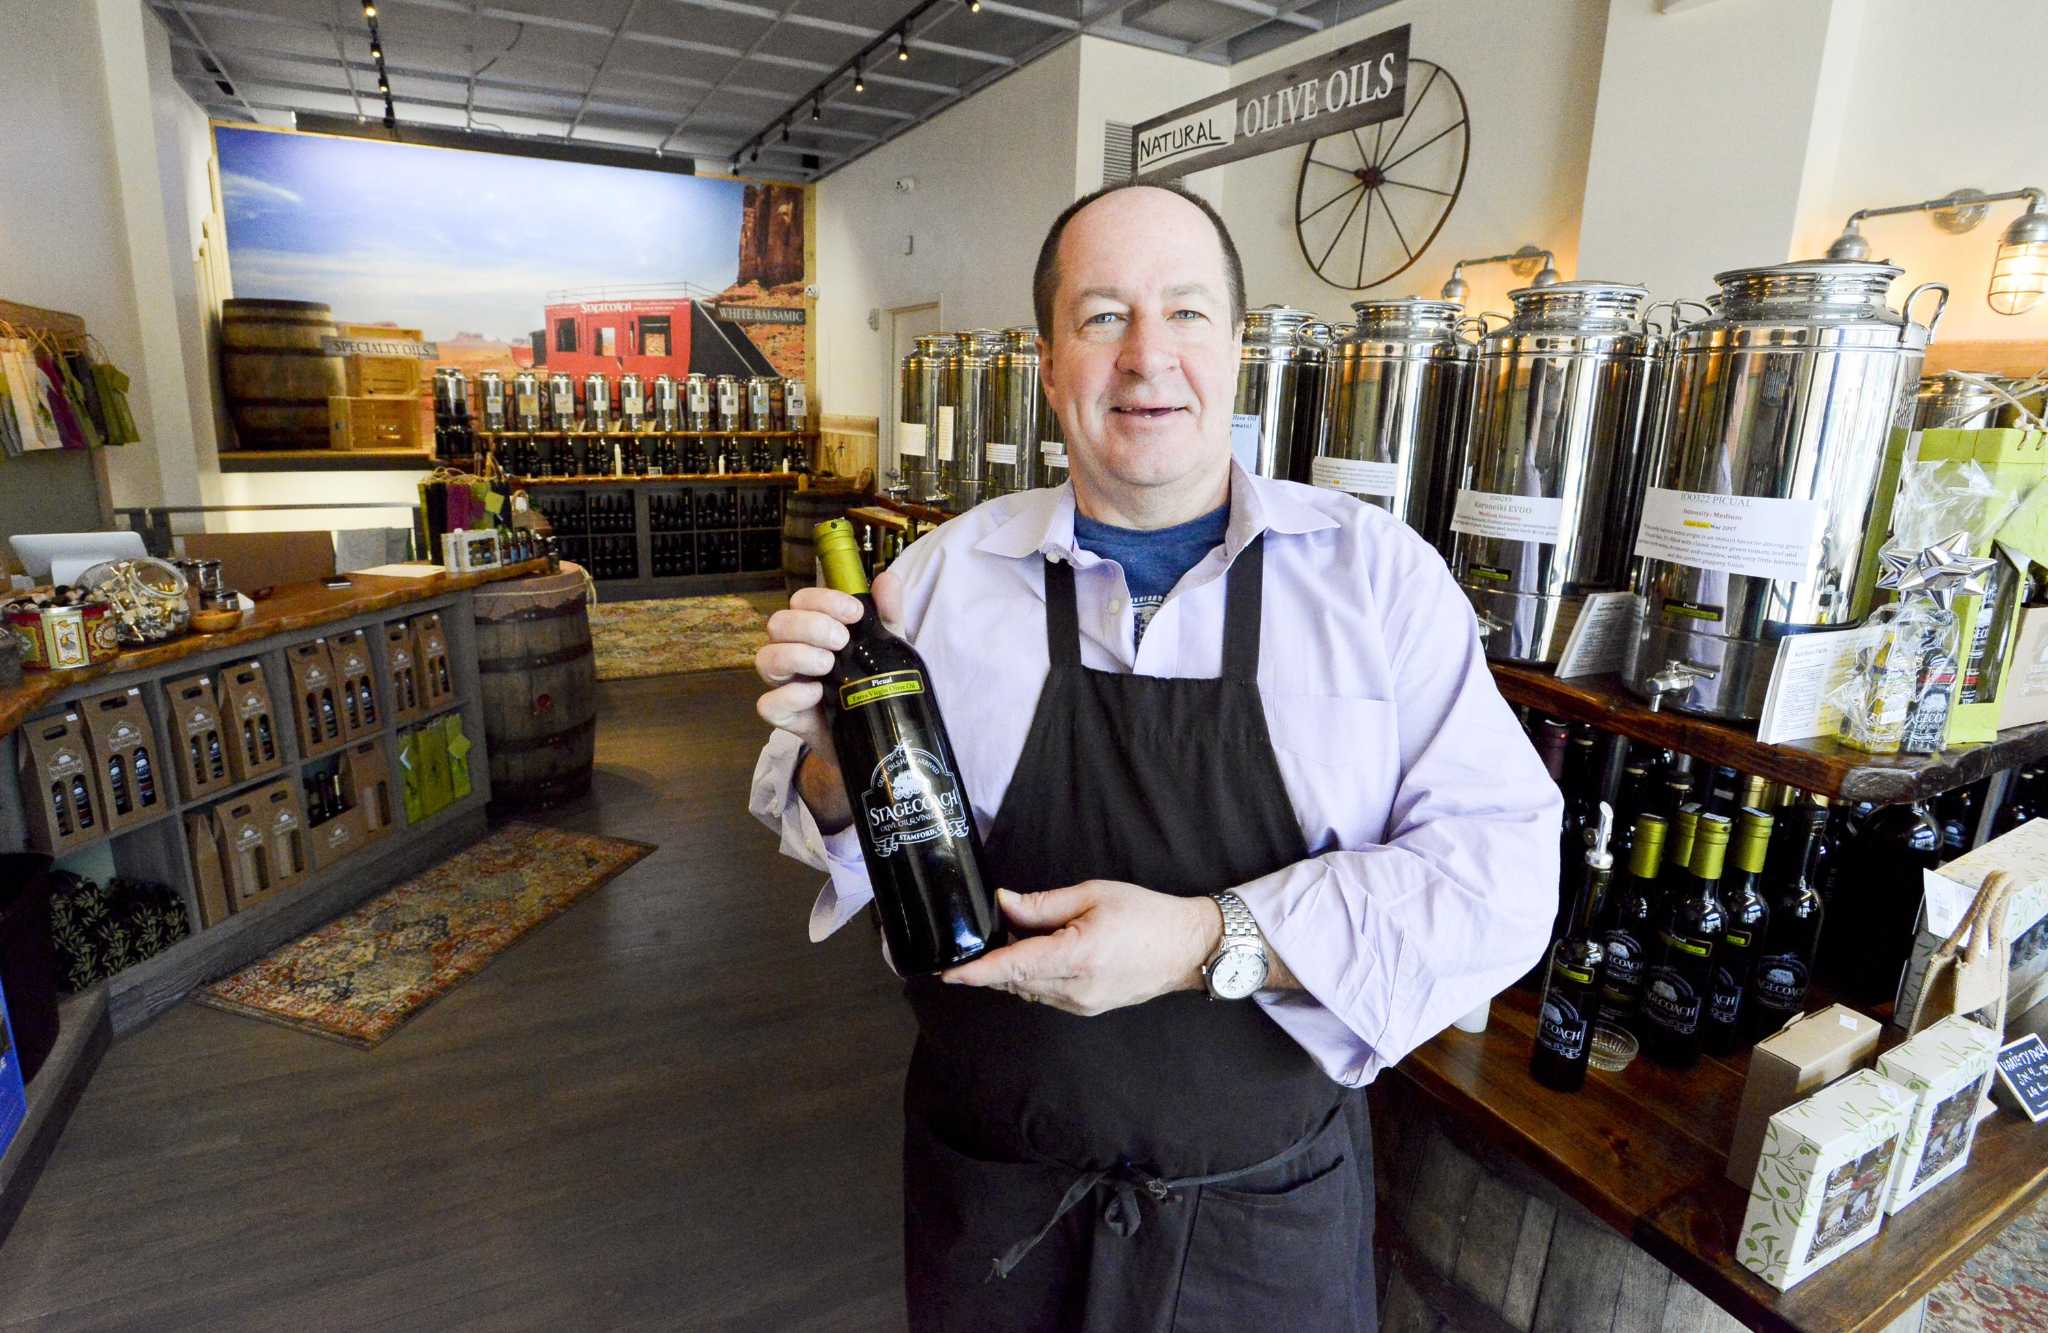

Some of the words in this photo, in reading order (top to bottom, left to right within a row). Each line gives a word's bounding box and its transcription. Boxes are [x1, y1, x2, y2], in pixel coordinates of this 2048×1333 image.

[1139, 119, 1221, 161] NATURAL
[1243, 79, 1320, 138] OLIVE
[1325, 53, 1395, 113] OILS
[719, 307, 753, 320] WHITE
[755, 308, 804, 322] BALSAMIC
[333, 340, 400, 354] SPECIALTY
[402, 344, 430, 356] OILS
[871, 675, 893, 687] Picual
[870, 789, 959, 826] STAGECOACH
